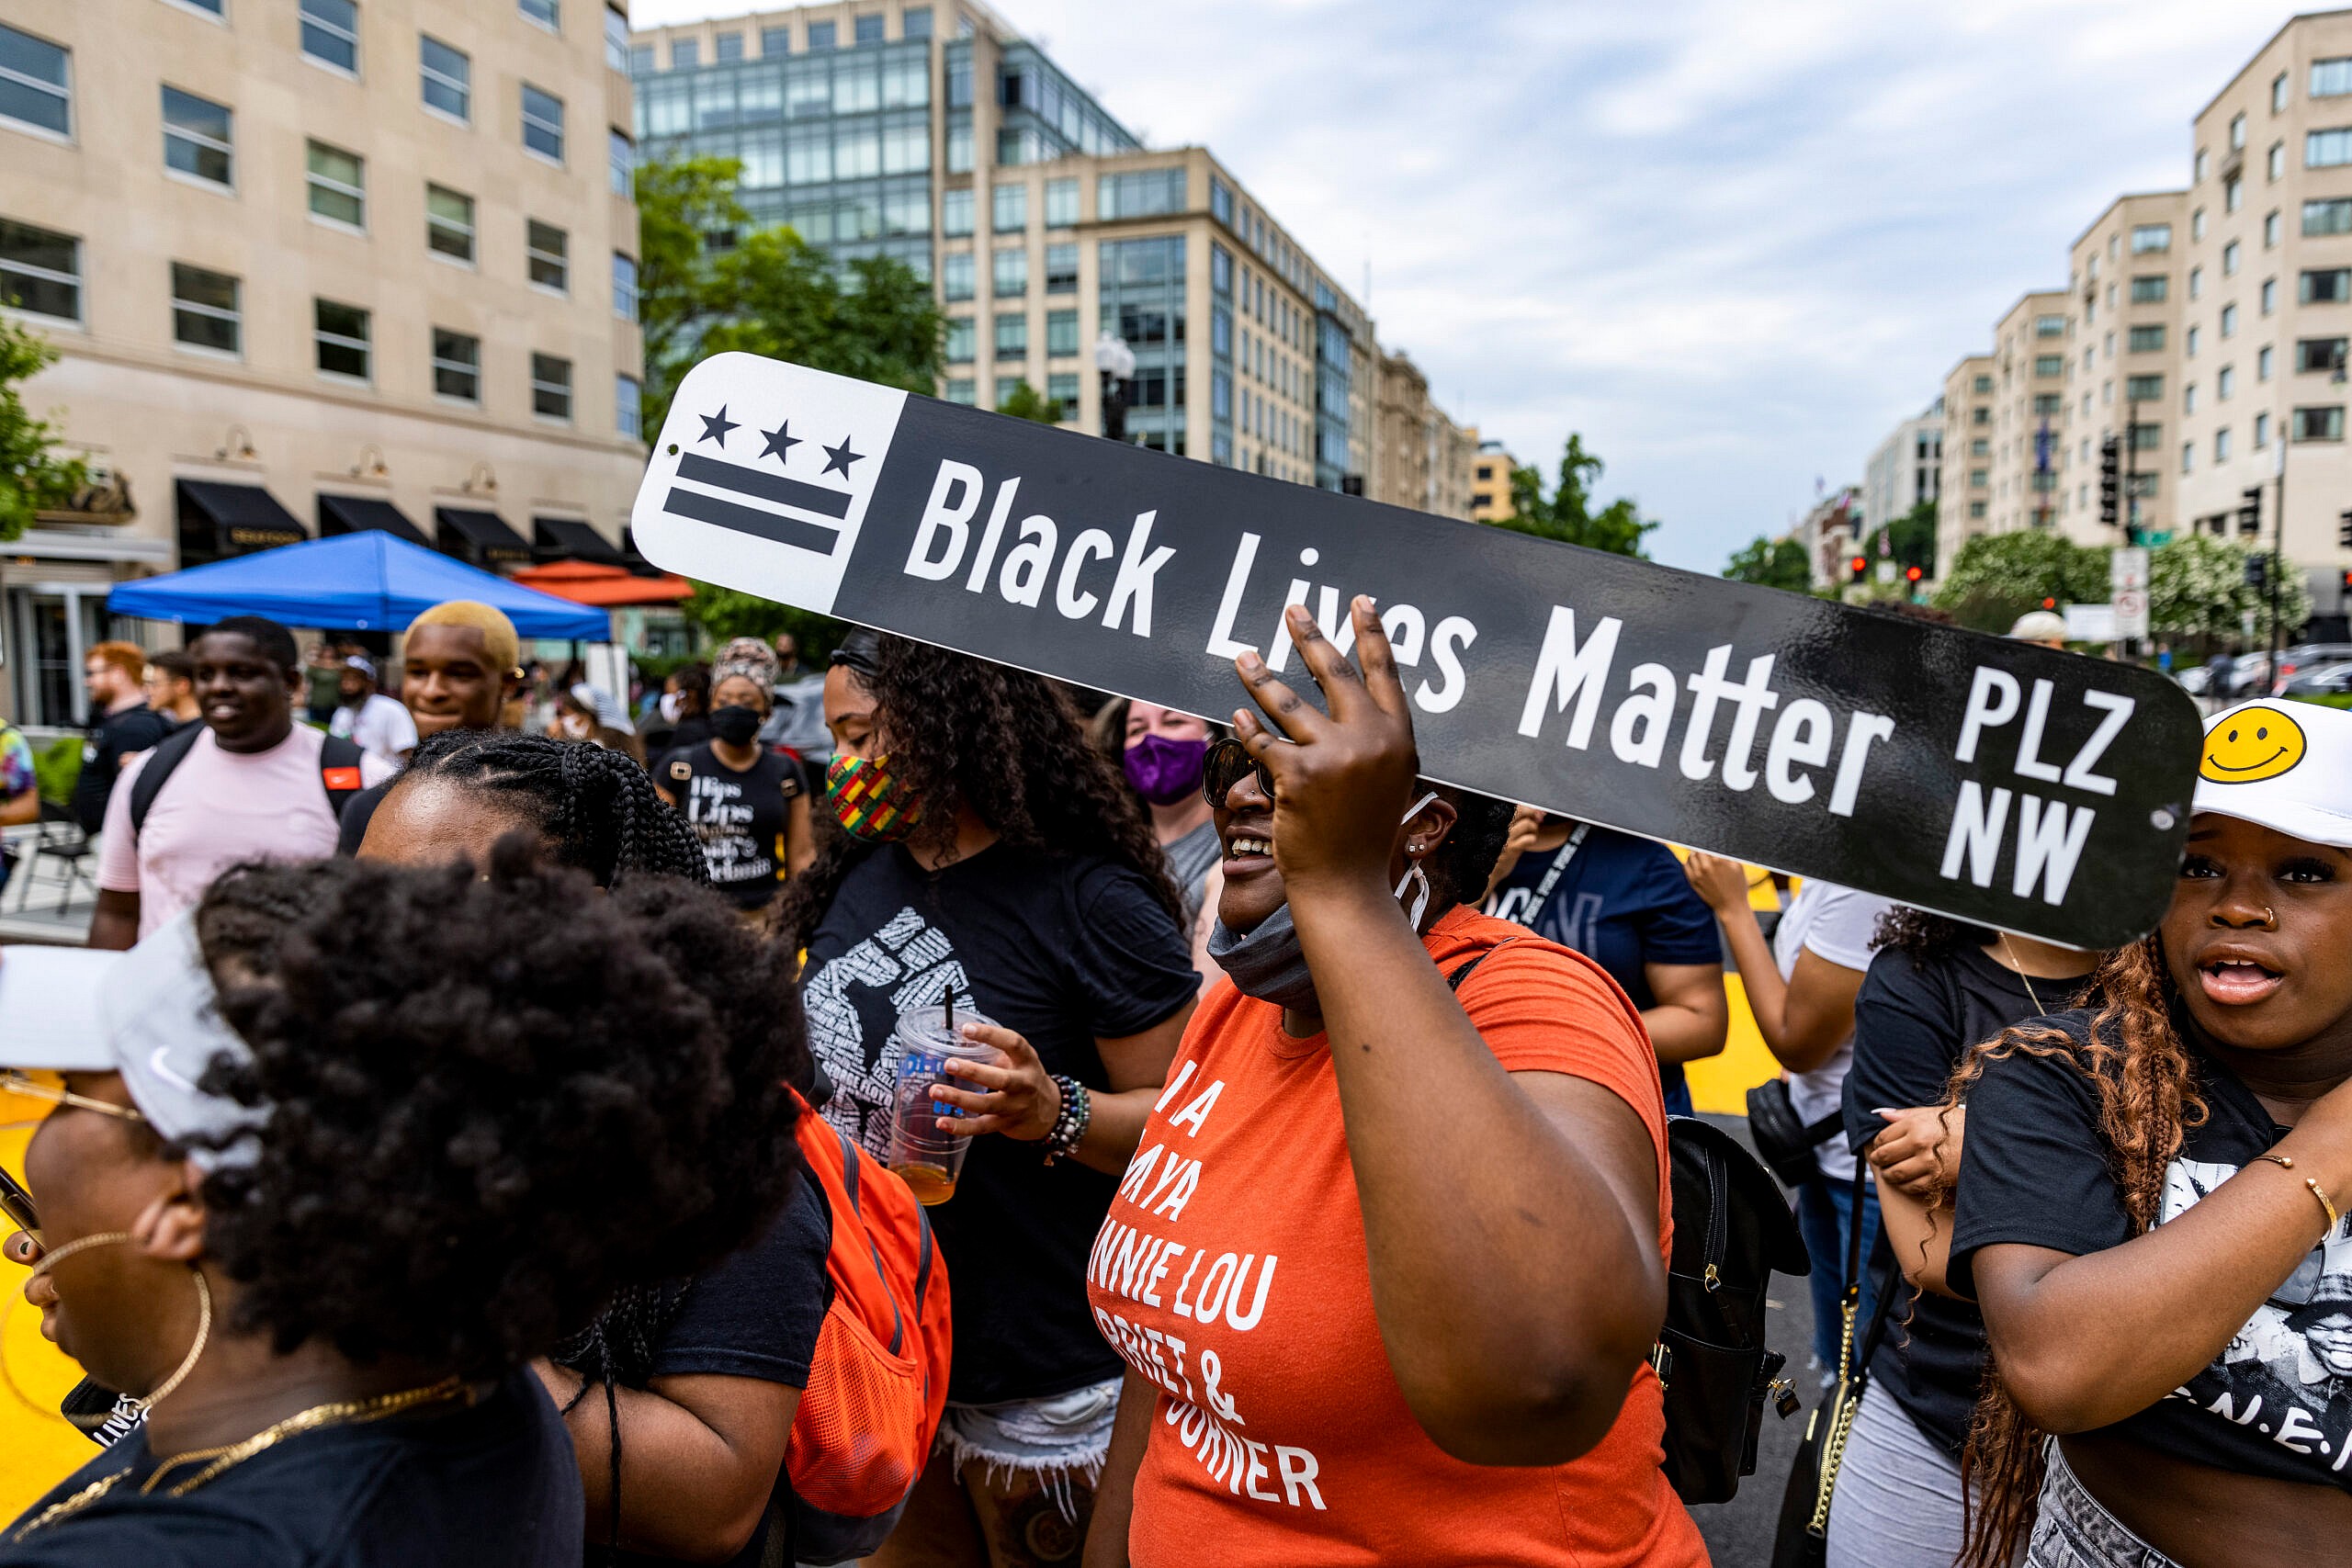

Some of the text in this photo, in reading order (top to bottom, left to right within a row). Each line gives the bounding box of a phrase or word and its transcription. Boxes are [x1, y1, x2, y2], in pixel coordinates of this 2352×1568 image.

[903, 458, 1897, 818] Black Lives Matter
[1954, 665, 2136, 796] PLZ
[1939, 779, 2097, 907] NW
[821, 1060, 861, 1090] GEORGE
[860, 1077, 894, 1107] FLOYD
[1173, 1249, 1278, 1331] LOU
[1200, 1349, 1247, 1427] &
